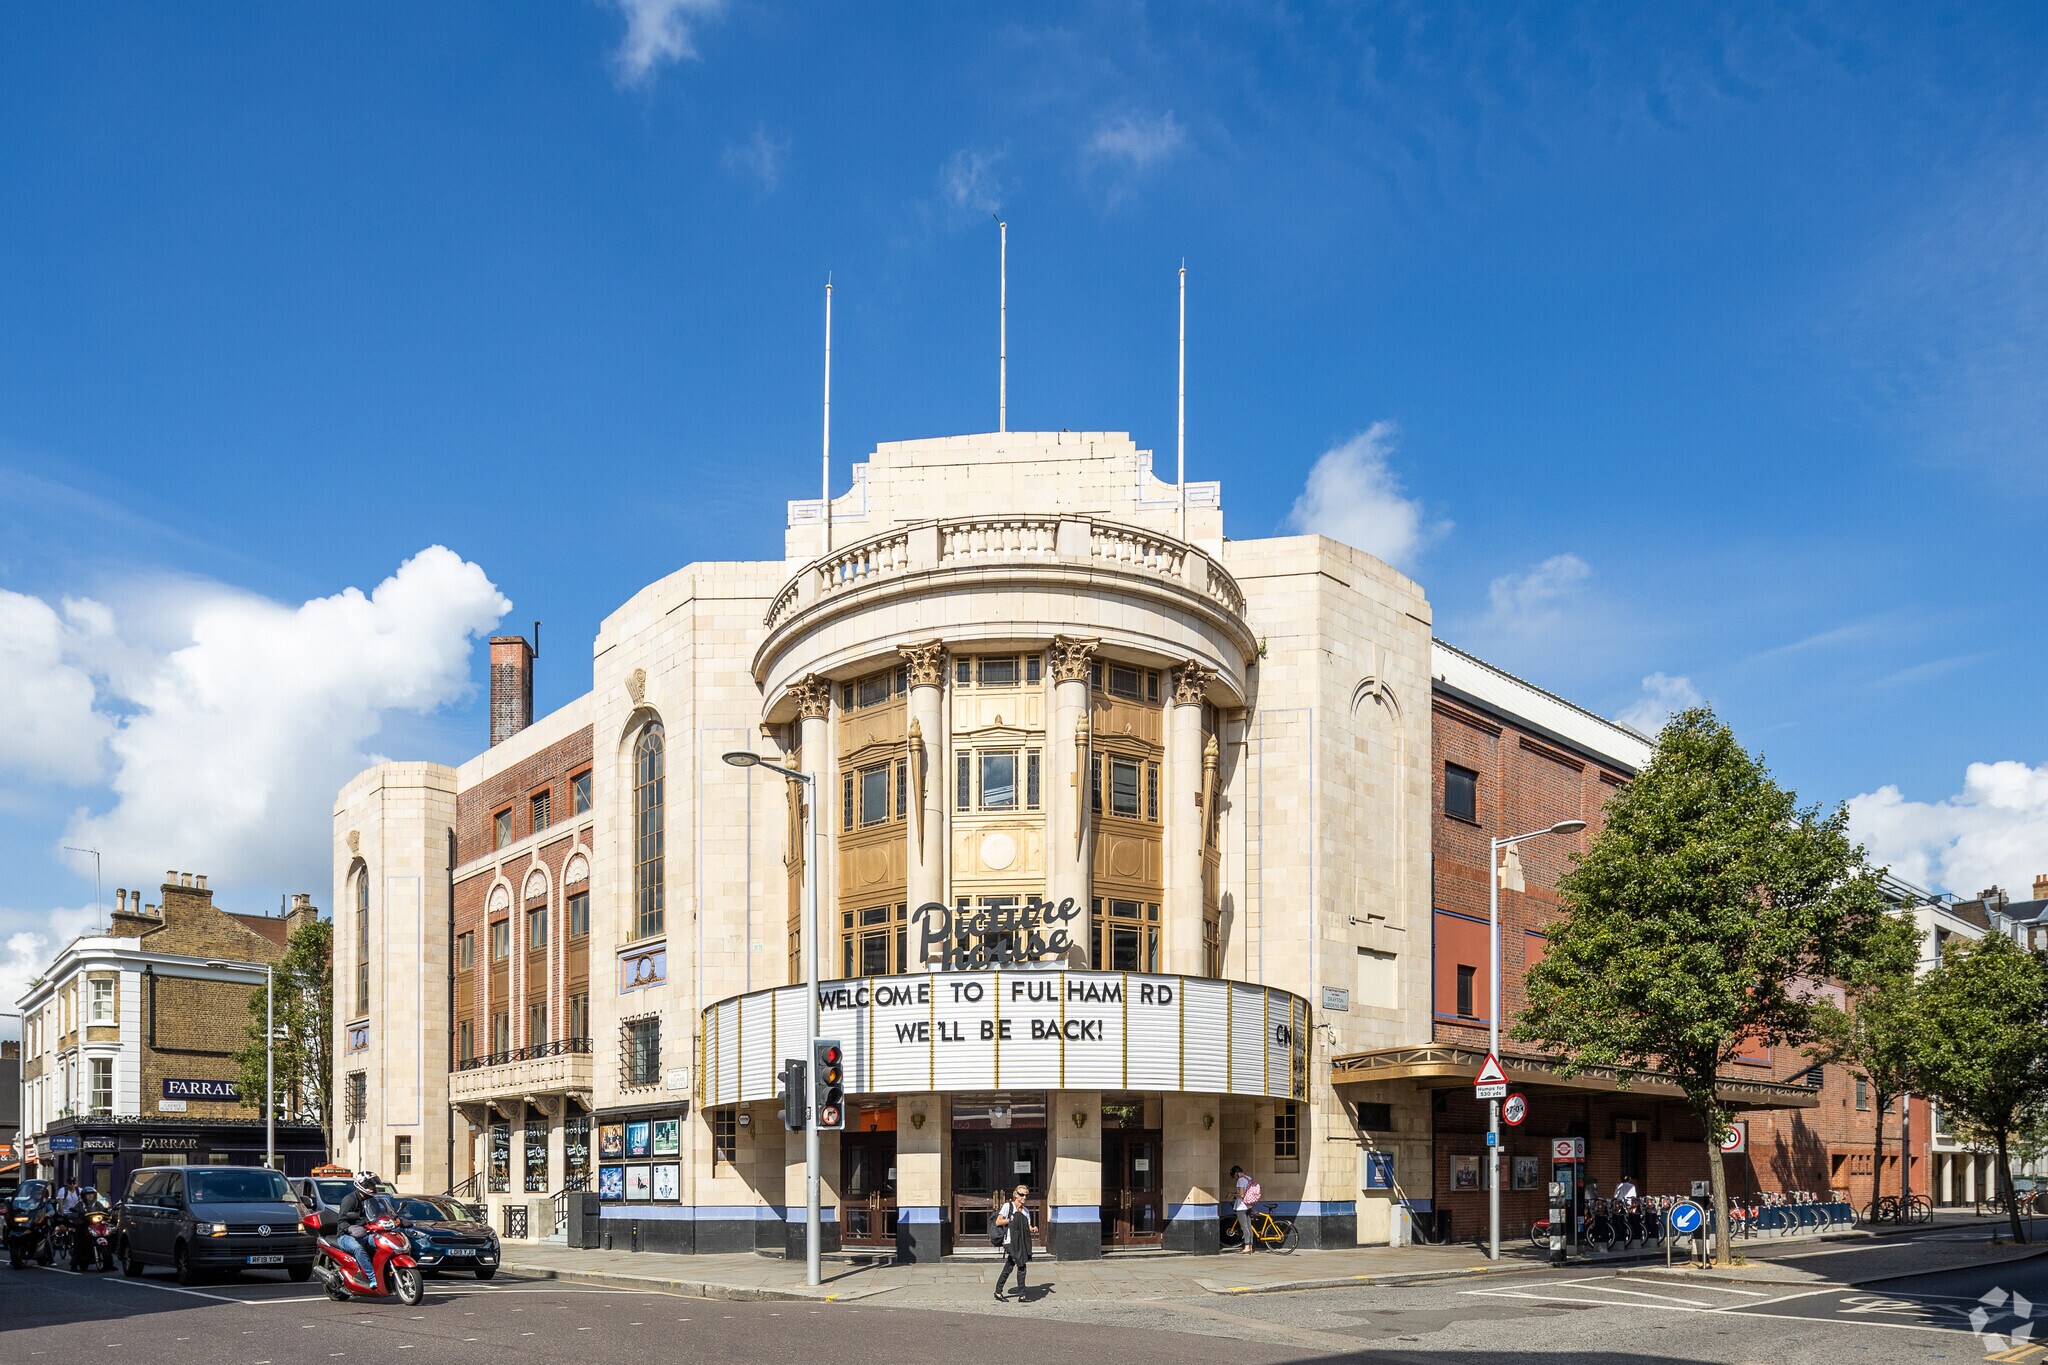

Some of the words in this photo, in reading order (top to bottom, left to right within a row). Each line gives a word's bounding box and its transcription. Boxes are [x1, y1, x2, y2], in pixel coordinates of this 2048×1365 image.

[912, 897, 1082, 963] Picture
[942, 929, 1074, 971] house
[819, 983, 930, 1011] WELCOME
[950, 982, 984, 1002] TO
[1011, 981, 1122, 1003] FULHAM
[1141, 983, 1173, 1005] RD
[895, 1021, 966, 1044] WE'LL
[981, 1020, 1012, 1040] BE
[1031, 1019, 1103, 1041] BACK!
[168, 1081, 237, 1096] FARRAR
[142, 1138, 198, 1149] FARRAR
